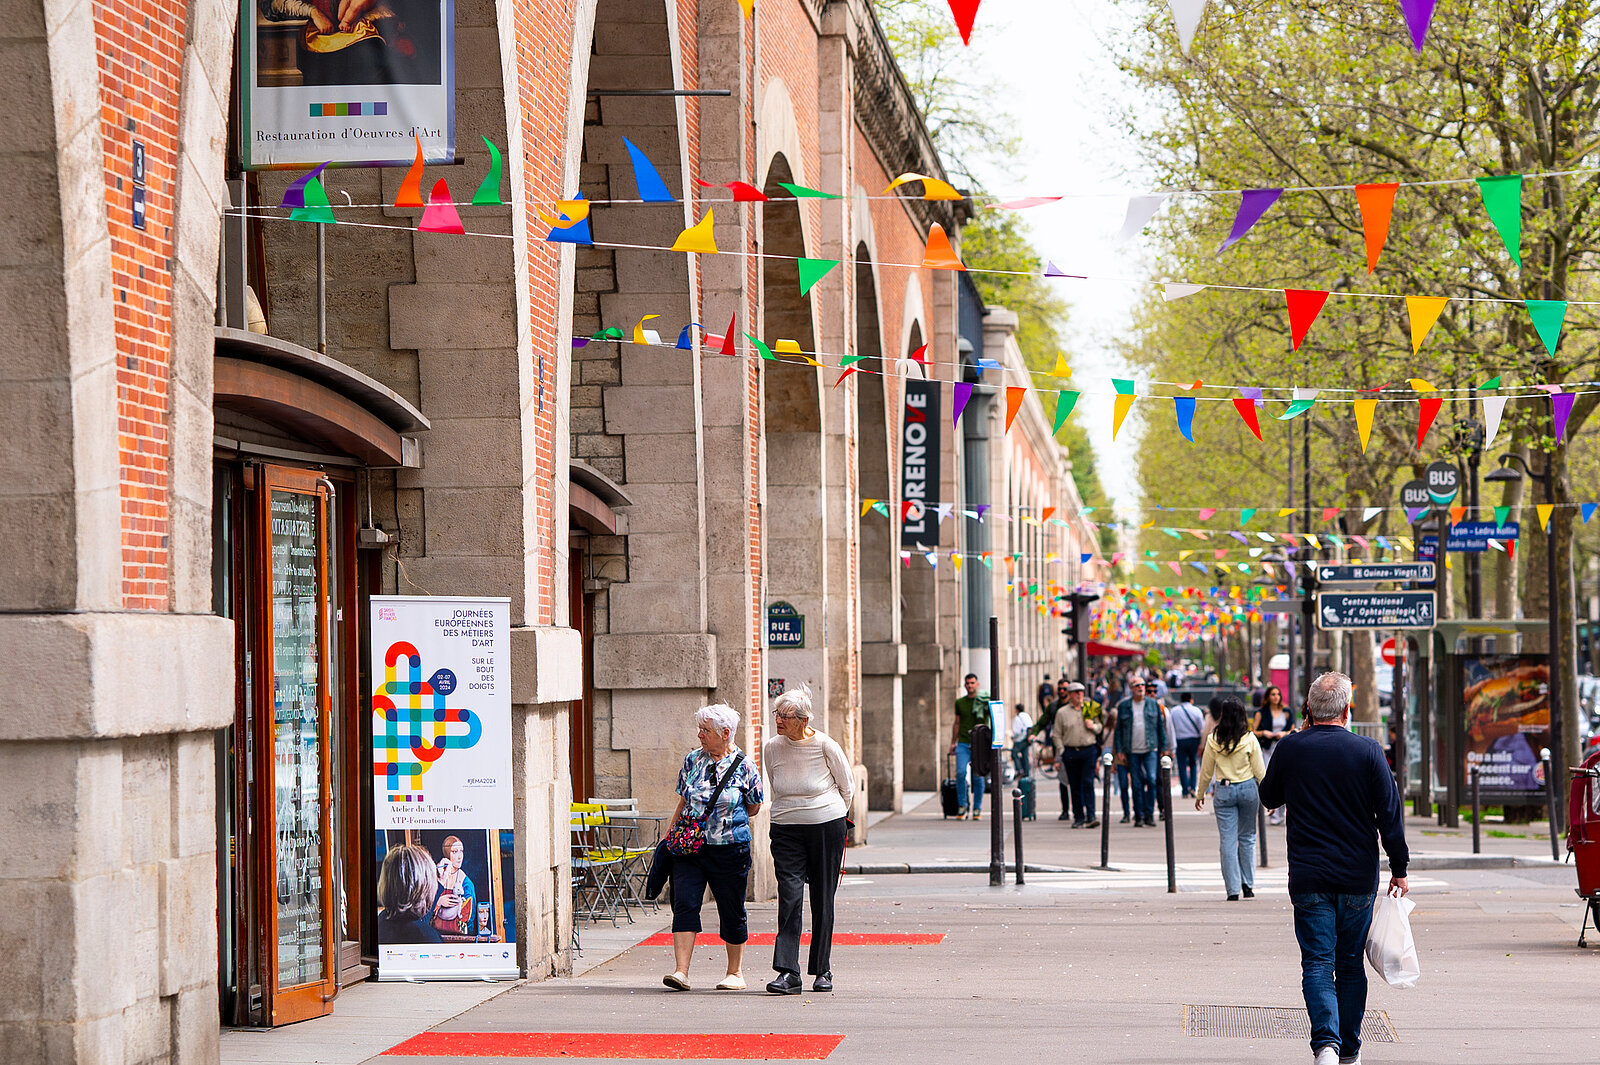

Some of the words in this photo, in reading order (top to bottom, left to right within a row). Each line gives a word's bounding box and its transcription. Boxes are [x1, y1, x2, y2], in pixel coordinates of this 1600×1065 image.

[256, 130, 336, 142] Restauration
[341, 127, 403, 139] d'Oeuvres
[408, 126, 442, 138] d'Art
[904, 394, 927, 533] LORENOVE
[1429, 471, 1456, 486] BUS
[1404, 488, 1429, 502] BUS
[1451, 527, 1468, 536] Lyon
[1475, 527, 1494, 535] Ledru
[1342, 598, 1368, 606] Centre
[1370, 597, 1404, 606] National
[452, 608, 494, 619] JOURNÉES
[1359, 608, 1416, 616] Ophtalmologie
[434, 618, 494, 628] EUROPÉENNES
[772, 622, 790, 631] RUE
[461, 628, 494, 637] MÉTIERS
[770, 632, 801, 641] OREAU
[1492, 750, 1512, 762] mis
[1512, 765, 1531, 774] sur
[427, 805, 451, 814] Temps
